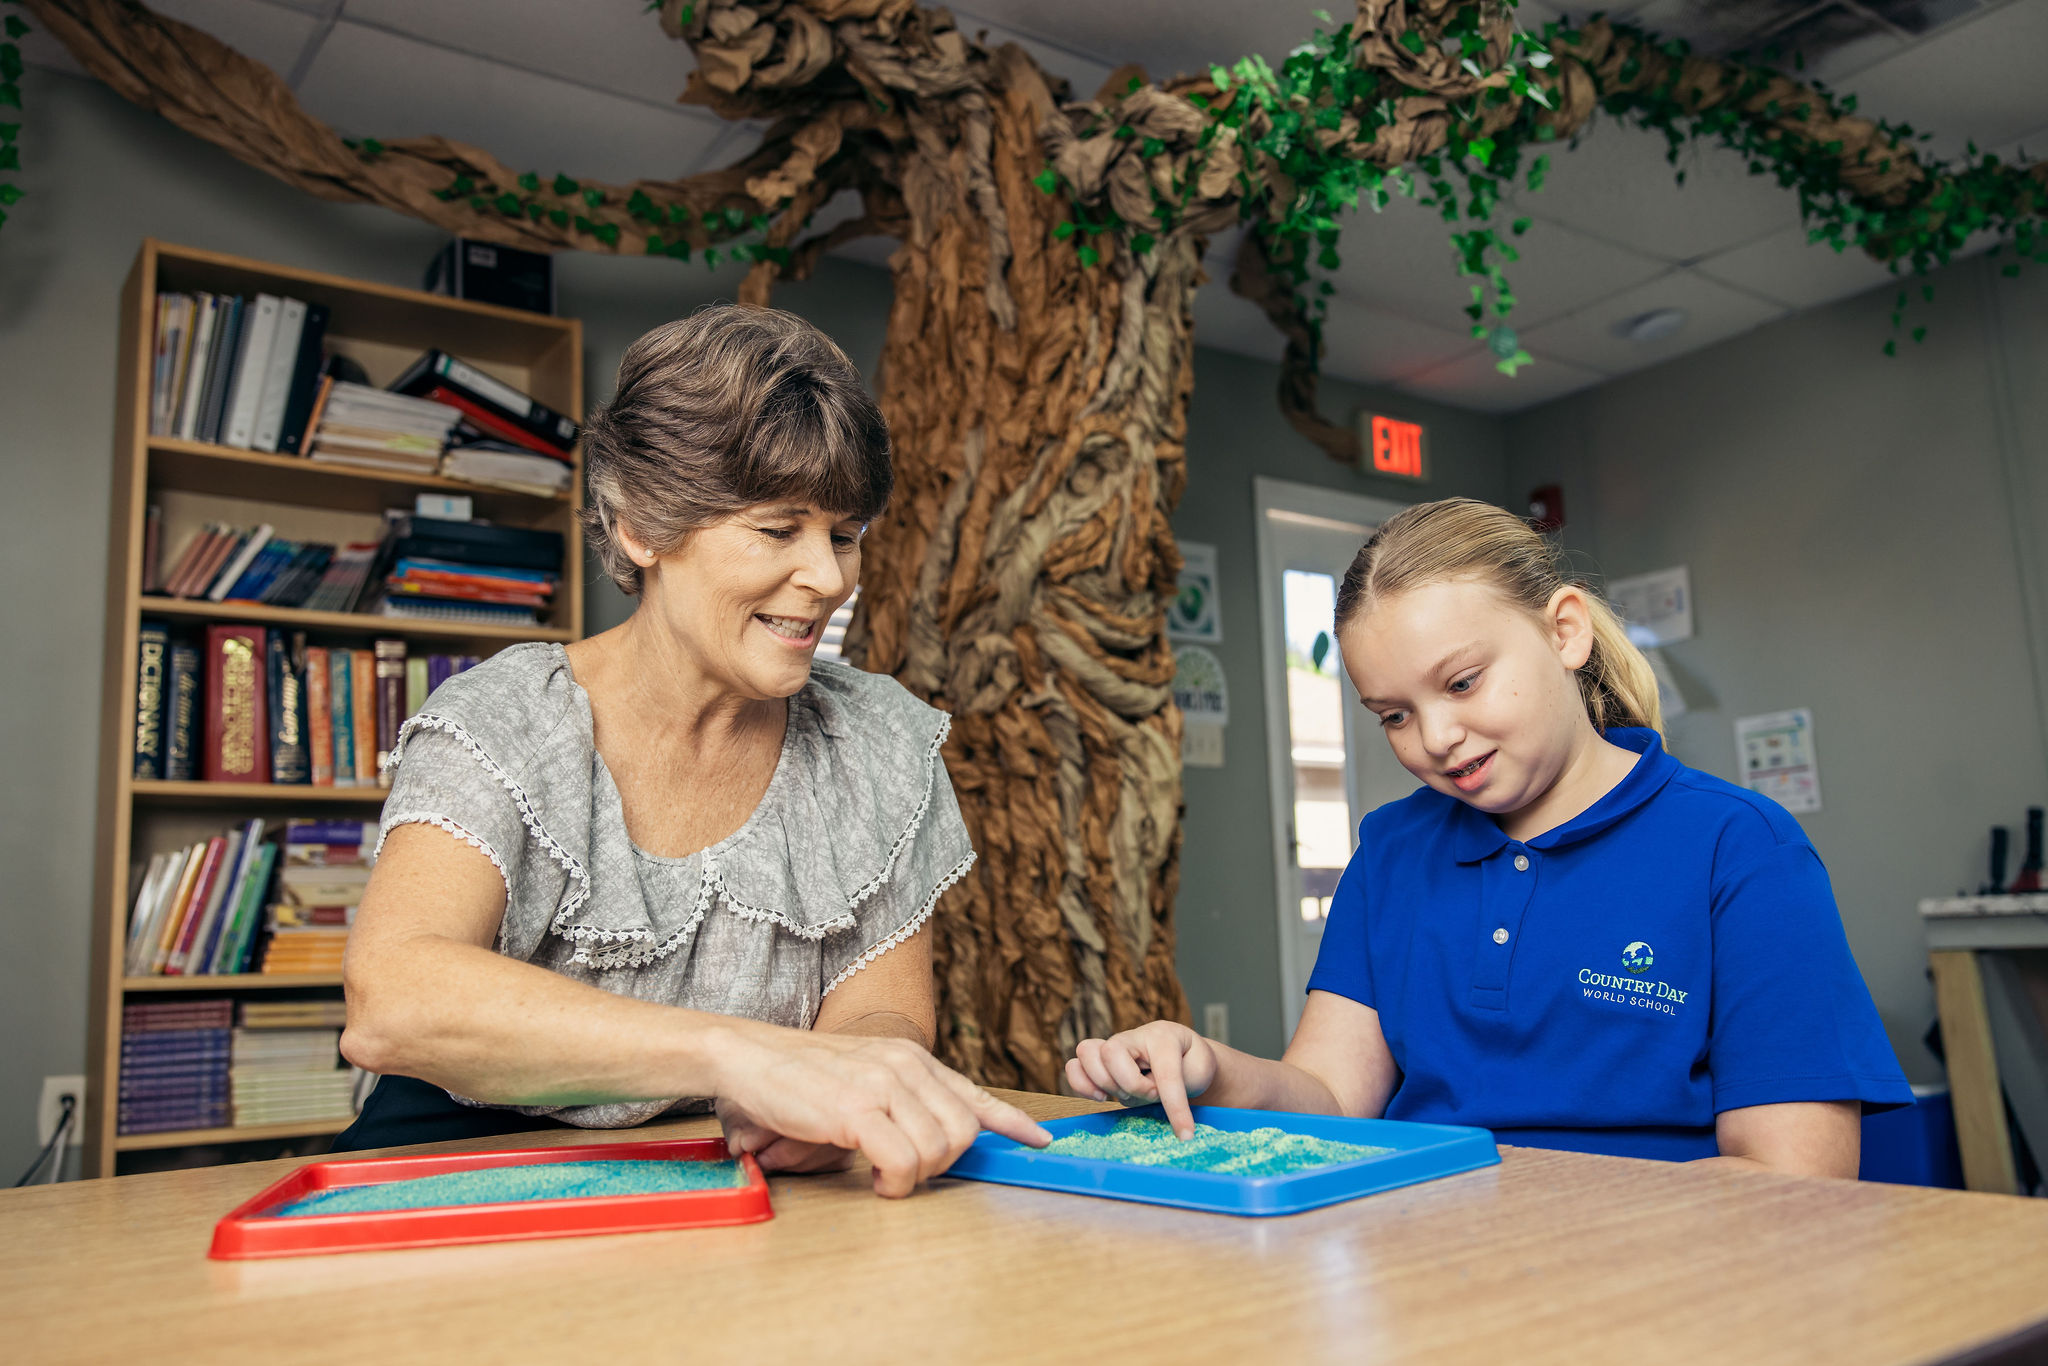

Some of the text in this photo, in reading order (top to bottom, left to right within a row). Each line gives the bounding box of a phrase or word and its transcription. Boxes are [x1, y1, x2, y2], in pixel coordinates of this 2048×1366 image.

[1372, 415, 1422, 477] EXIT
[1578, 968, 1688, 1004] COUNTRY DAY
[1583, 988, 1676, 1016] WORLD SCHOOL
